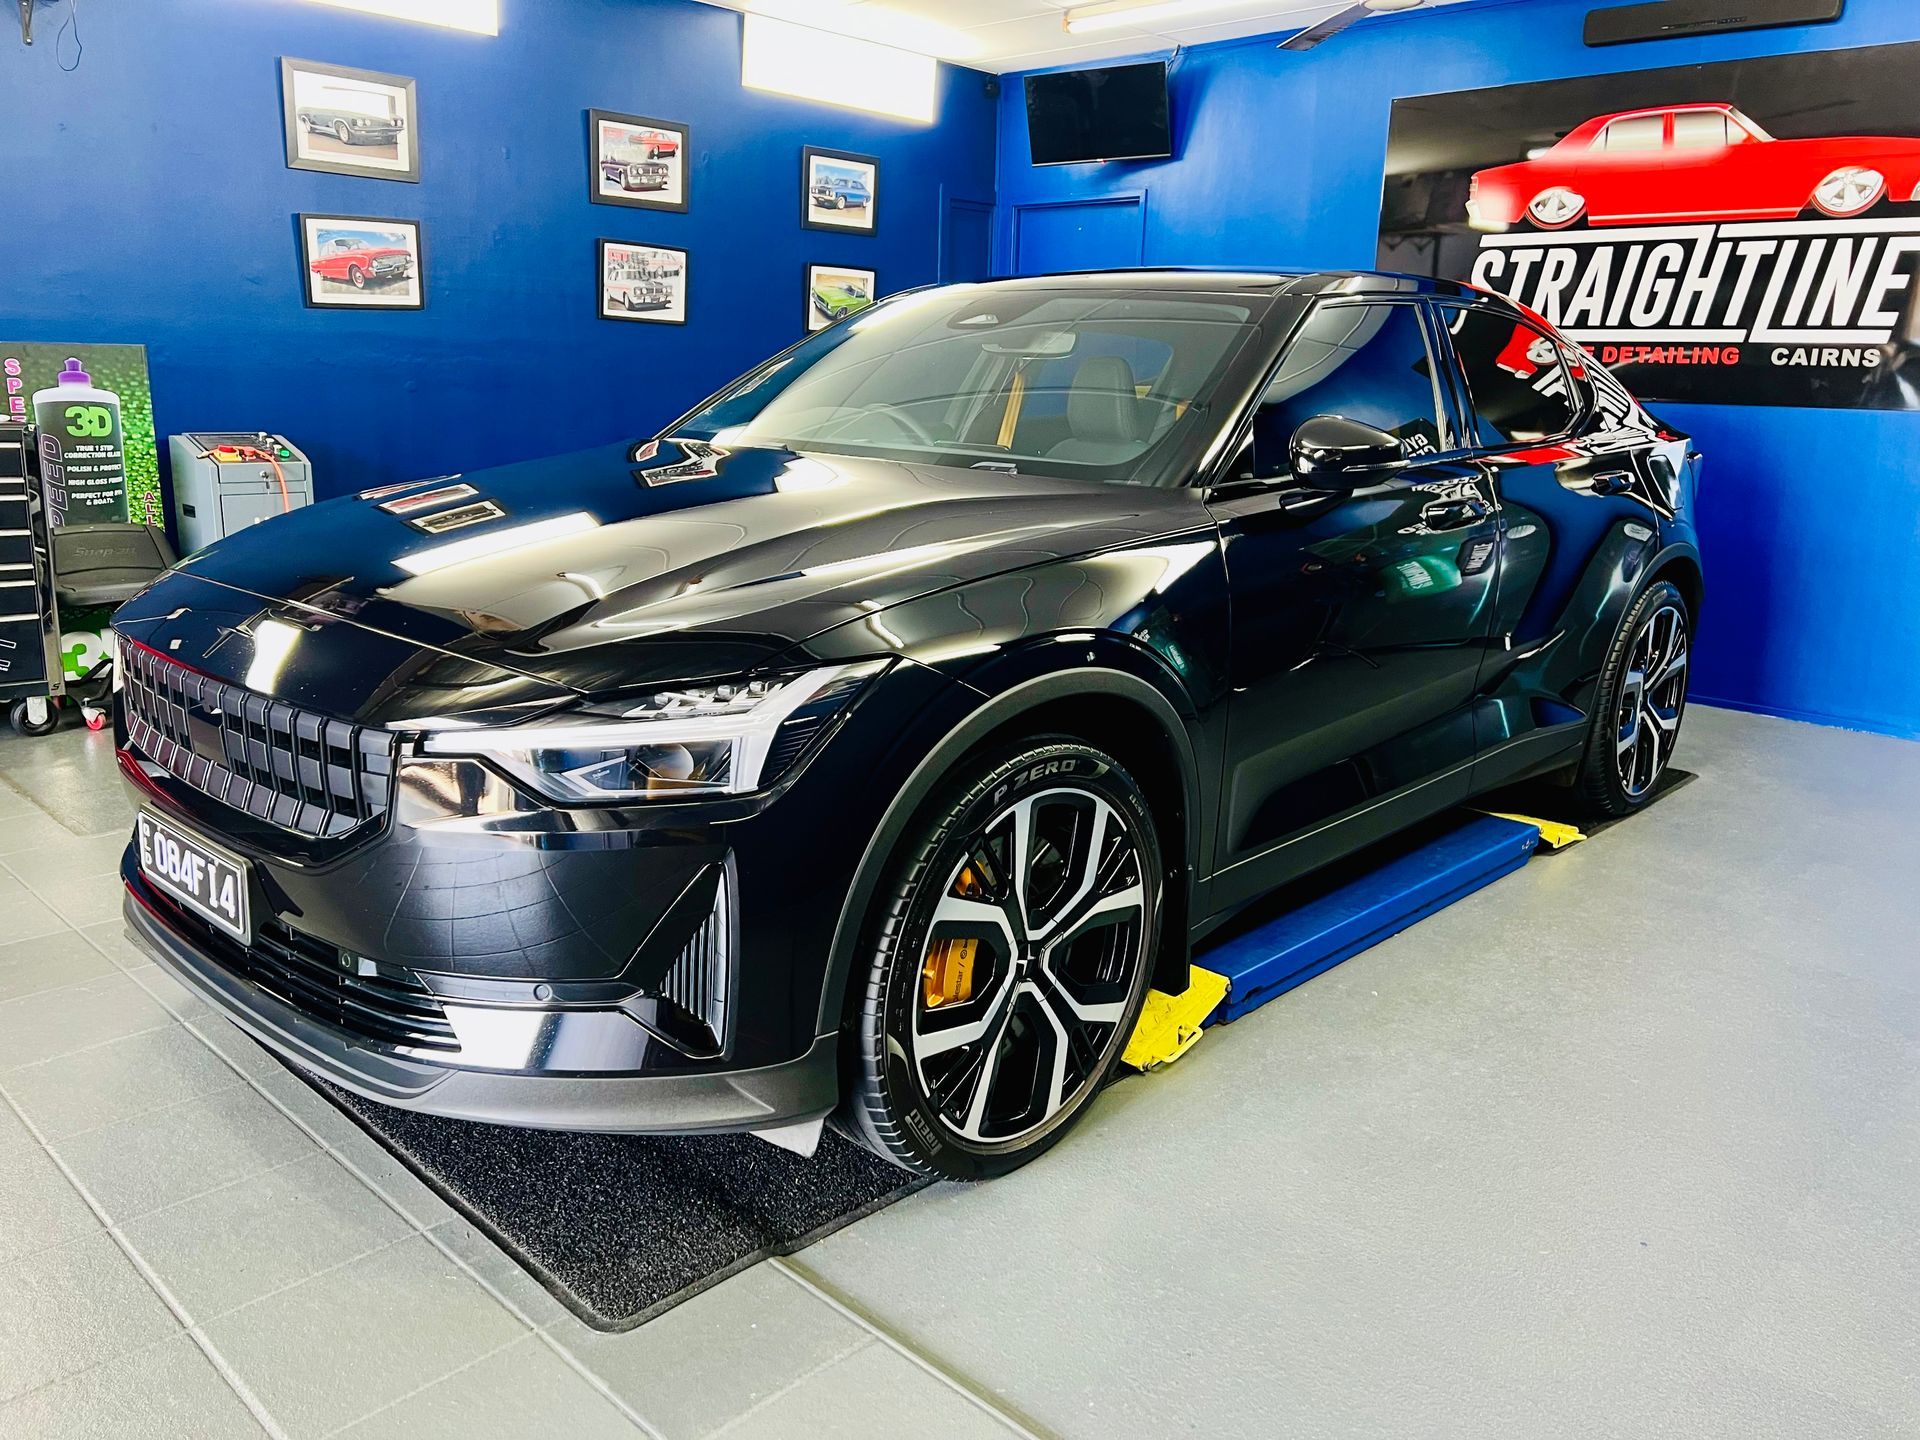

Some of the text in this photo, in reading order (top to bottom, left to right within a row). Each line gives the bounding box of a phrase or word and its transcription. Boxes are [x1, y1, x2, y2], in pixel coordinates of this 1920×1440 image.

[1470, 221, 1920, 342] STRAIGHTLINE
[1602, 346, 1740, 364] DETAILING
[1770, 347, 1881, 367] CAIRNS
[65, 406, 113, 437] 3D
[41, 433, 69, 528] PEED
[993, 759, 1076, 804] P ZERO
